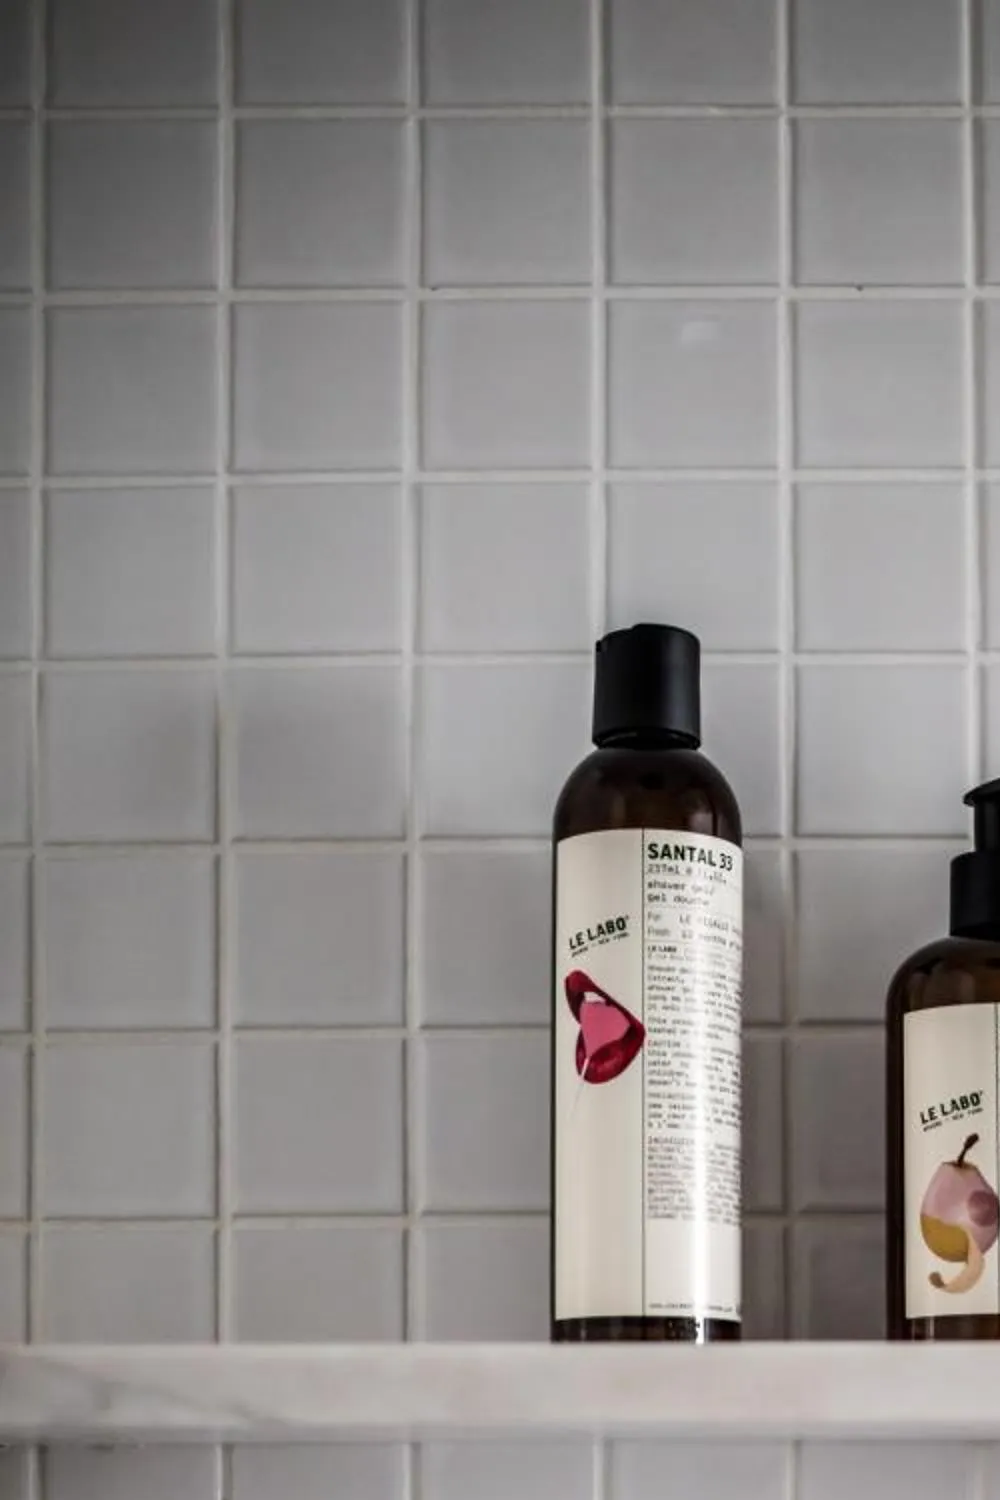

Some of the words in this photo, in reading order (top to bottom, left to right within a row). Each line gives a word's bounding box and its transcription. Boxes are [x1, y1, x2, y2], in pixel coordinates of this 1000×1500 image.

[648, 843, 716, 867] SANTAL
[720, 853, 733, 872] 33
[569, 931, 585, 950] LE
[587, 914, 630, 941] LABO
[920, 1106, 938, 1125] LE
[940, 1090, 984, 1116] LABO
